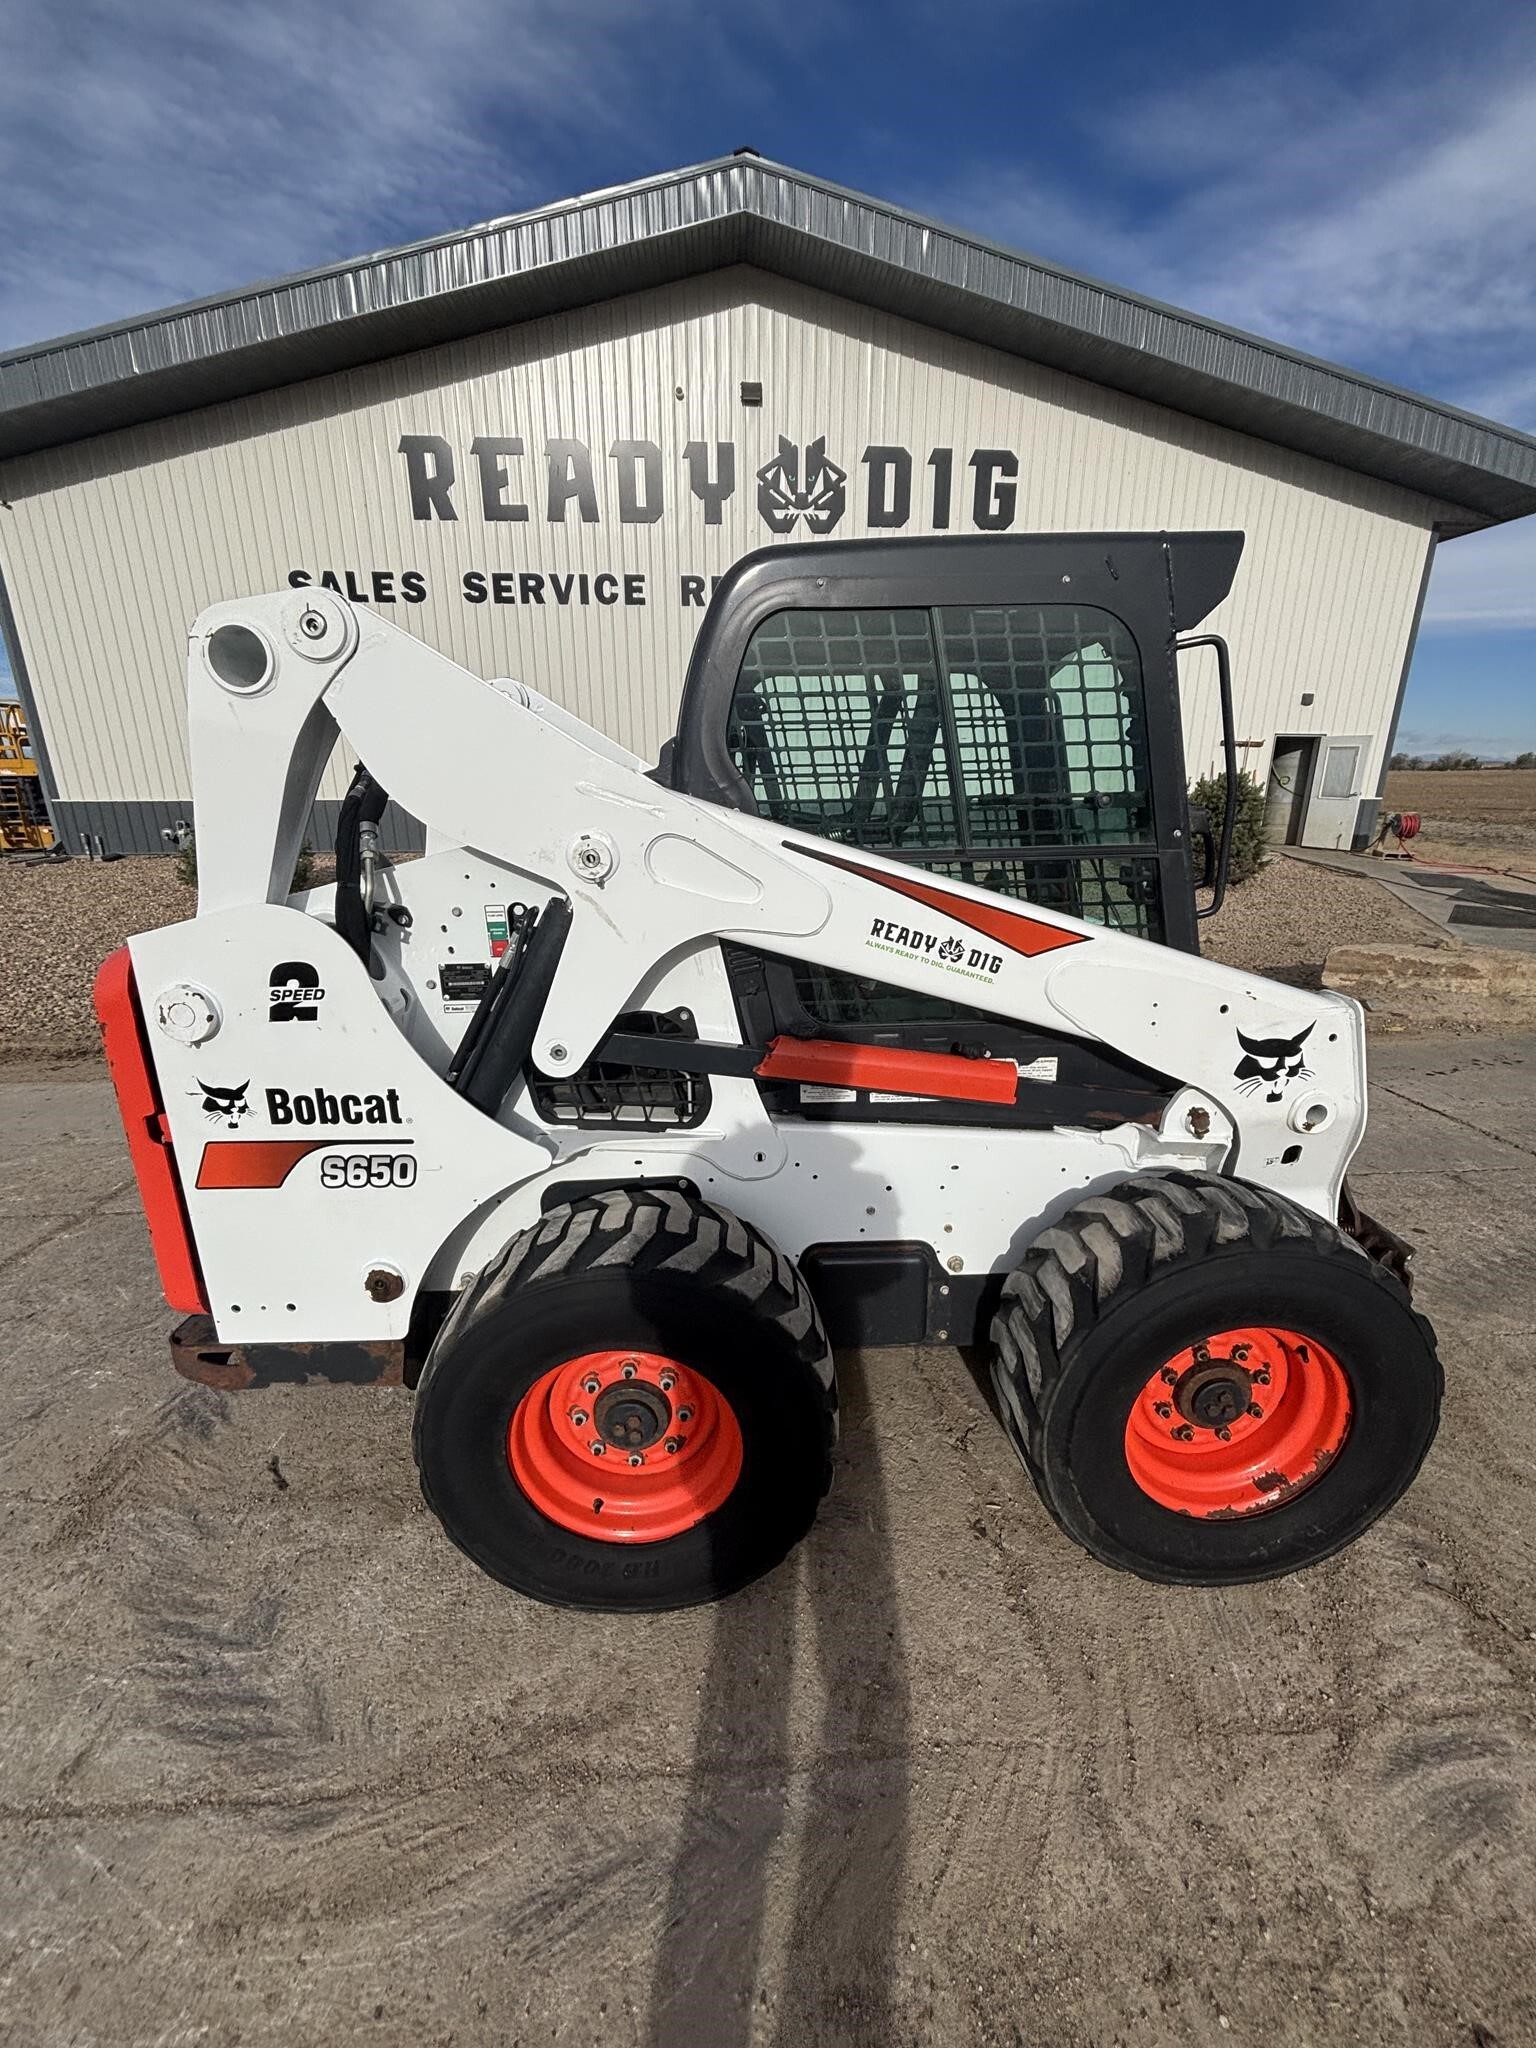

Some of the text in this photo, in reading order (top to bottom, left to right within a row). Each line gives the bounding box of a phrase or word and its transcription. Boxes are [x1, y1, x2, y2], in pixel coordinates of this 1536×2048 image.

[398, 434, 1019, 531] READY DIG
[288, 569, 427, 604] SALES
[462, 573, 646, 606] SERVICE
[865, 939, 994, 985] ALWAYS READY TO DIG. GUARANTEED.
[870, 918, 1003, 974] READY DIG
[269, 961, 319, 1022] 2
[270, 988, 325, 1001] SPEED
[265, 1088, 402, 1125] Bobcat
[320, 1154, 417, 1188] S650
